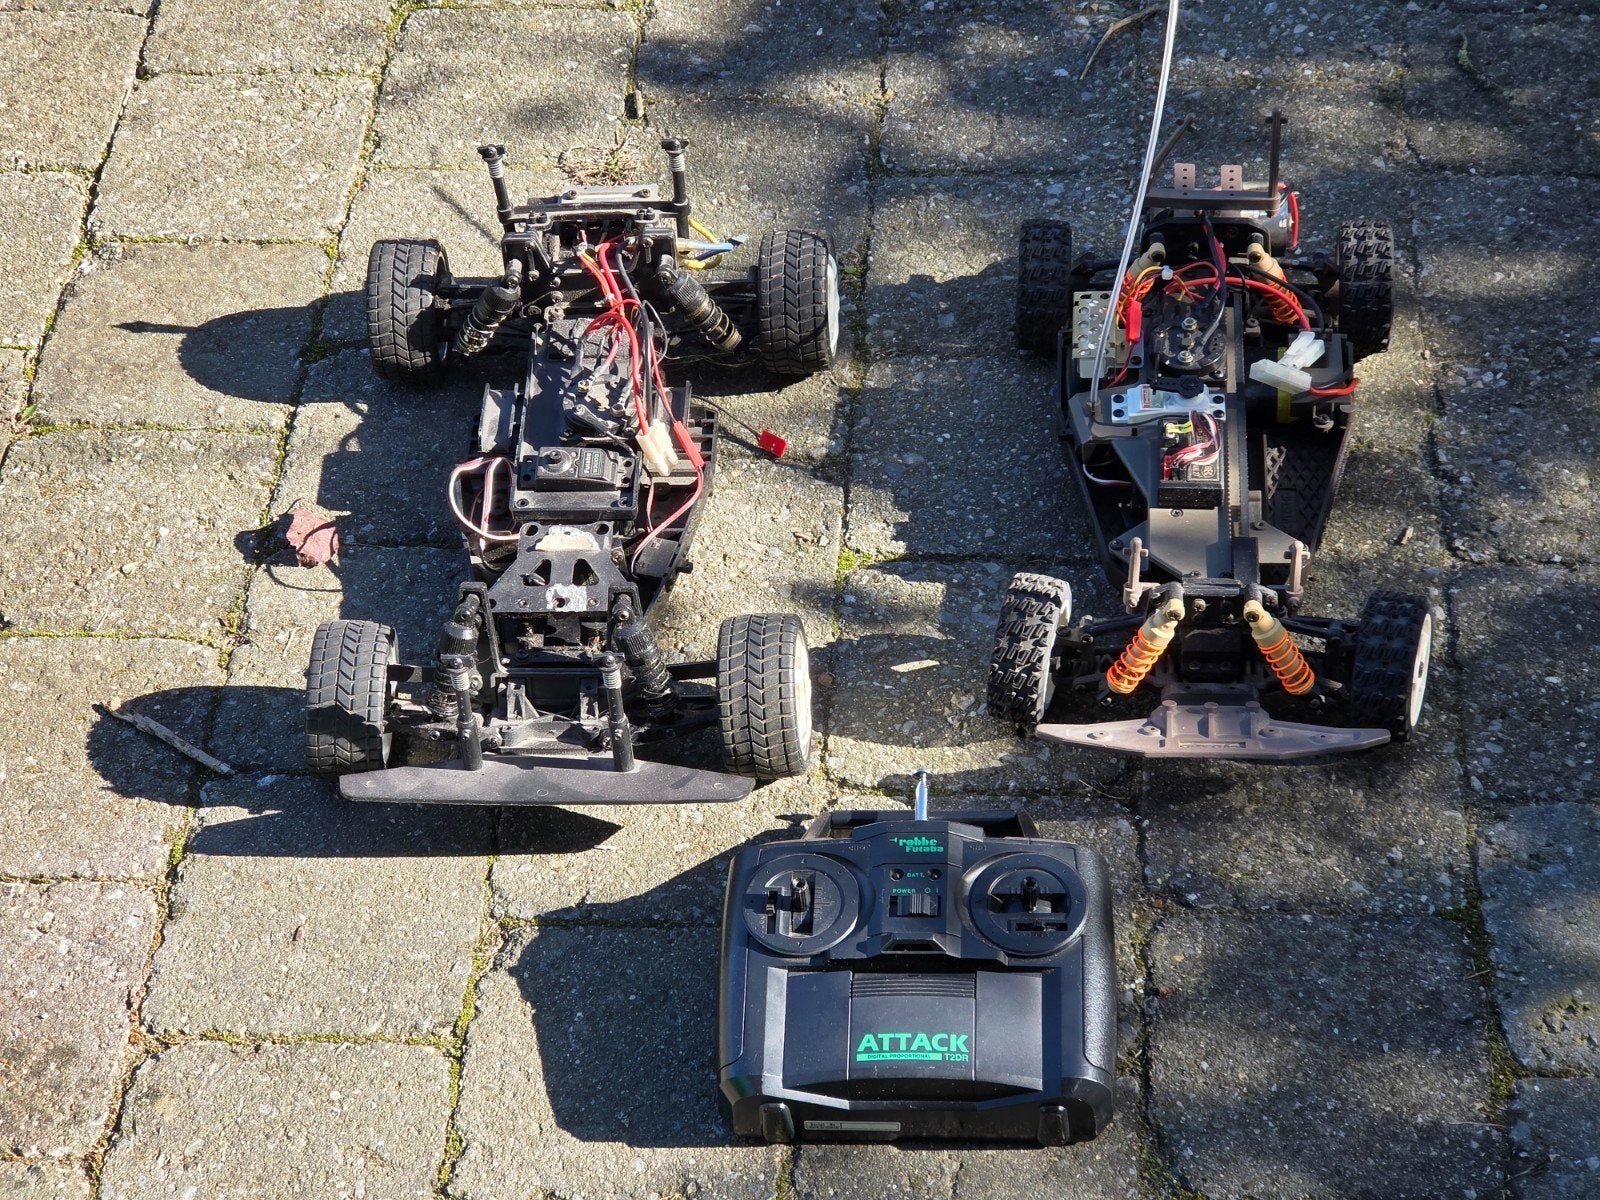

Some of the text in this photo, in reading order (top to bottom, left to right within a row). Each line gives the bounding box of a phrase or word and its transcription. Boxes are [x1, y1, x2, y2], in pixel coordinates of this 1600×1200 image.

[899, 837, 937, 846] robbe
[857, 1033, 969, 1052] ATTACK
[944, 1053, 969, 1062] T2DR
